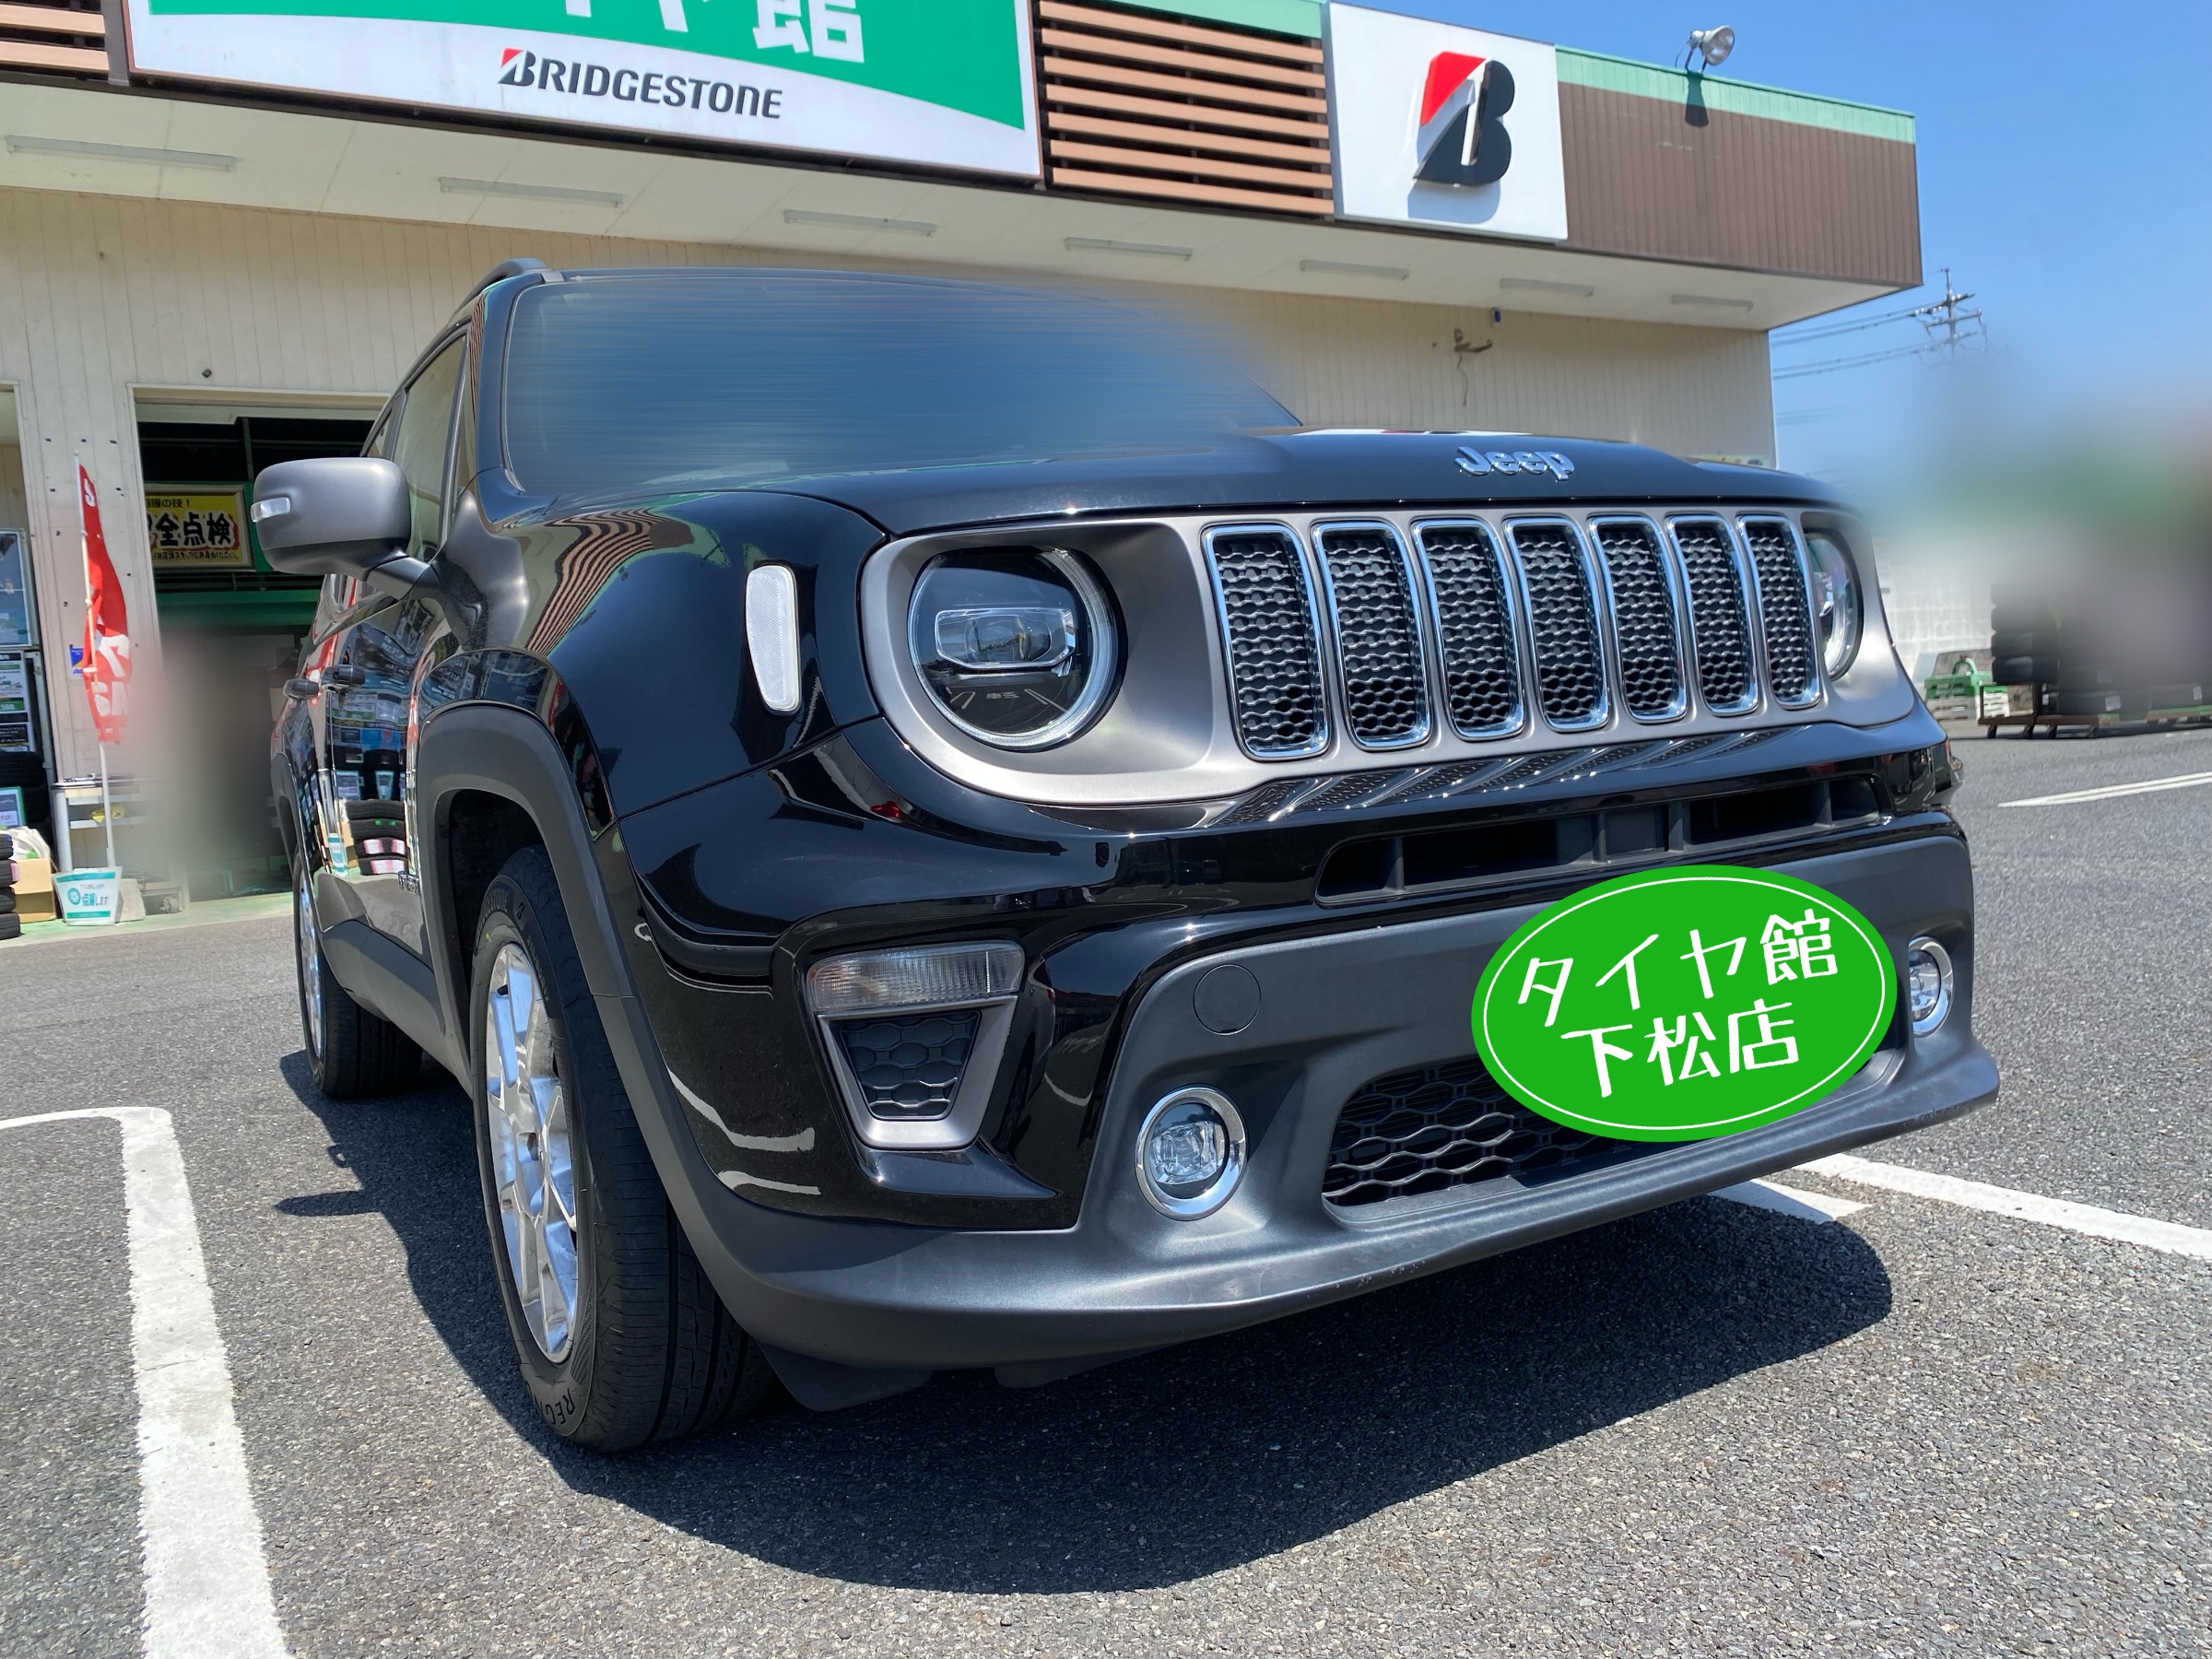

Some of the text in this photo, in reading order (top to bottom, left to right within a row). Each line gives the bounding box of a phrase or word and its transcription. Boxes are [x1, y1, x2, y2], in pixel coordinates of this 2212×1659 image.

[498, 47, 782, 120] BRIDGESTONE
[1454, 446, 1575, 481] Jeep
[147, 512, 231, 547] 全点検
